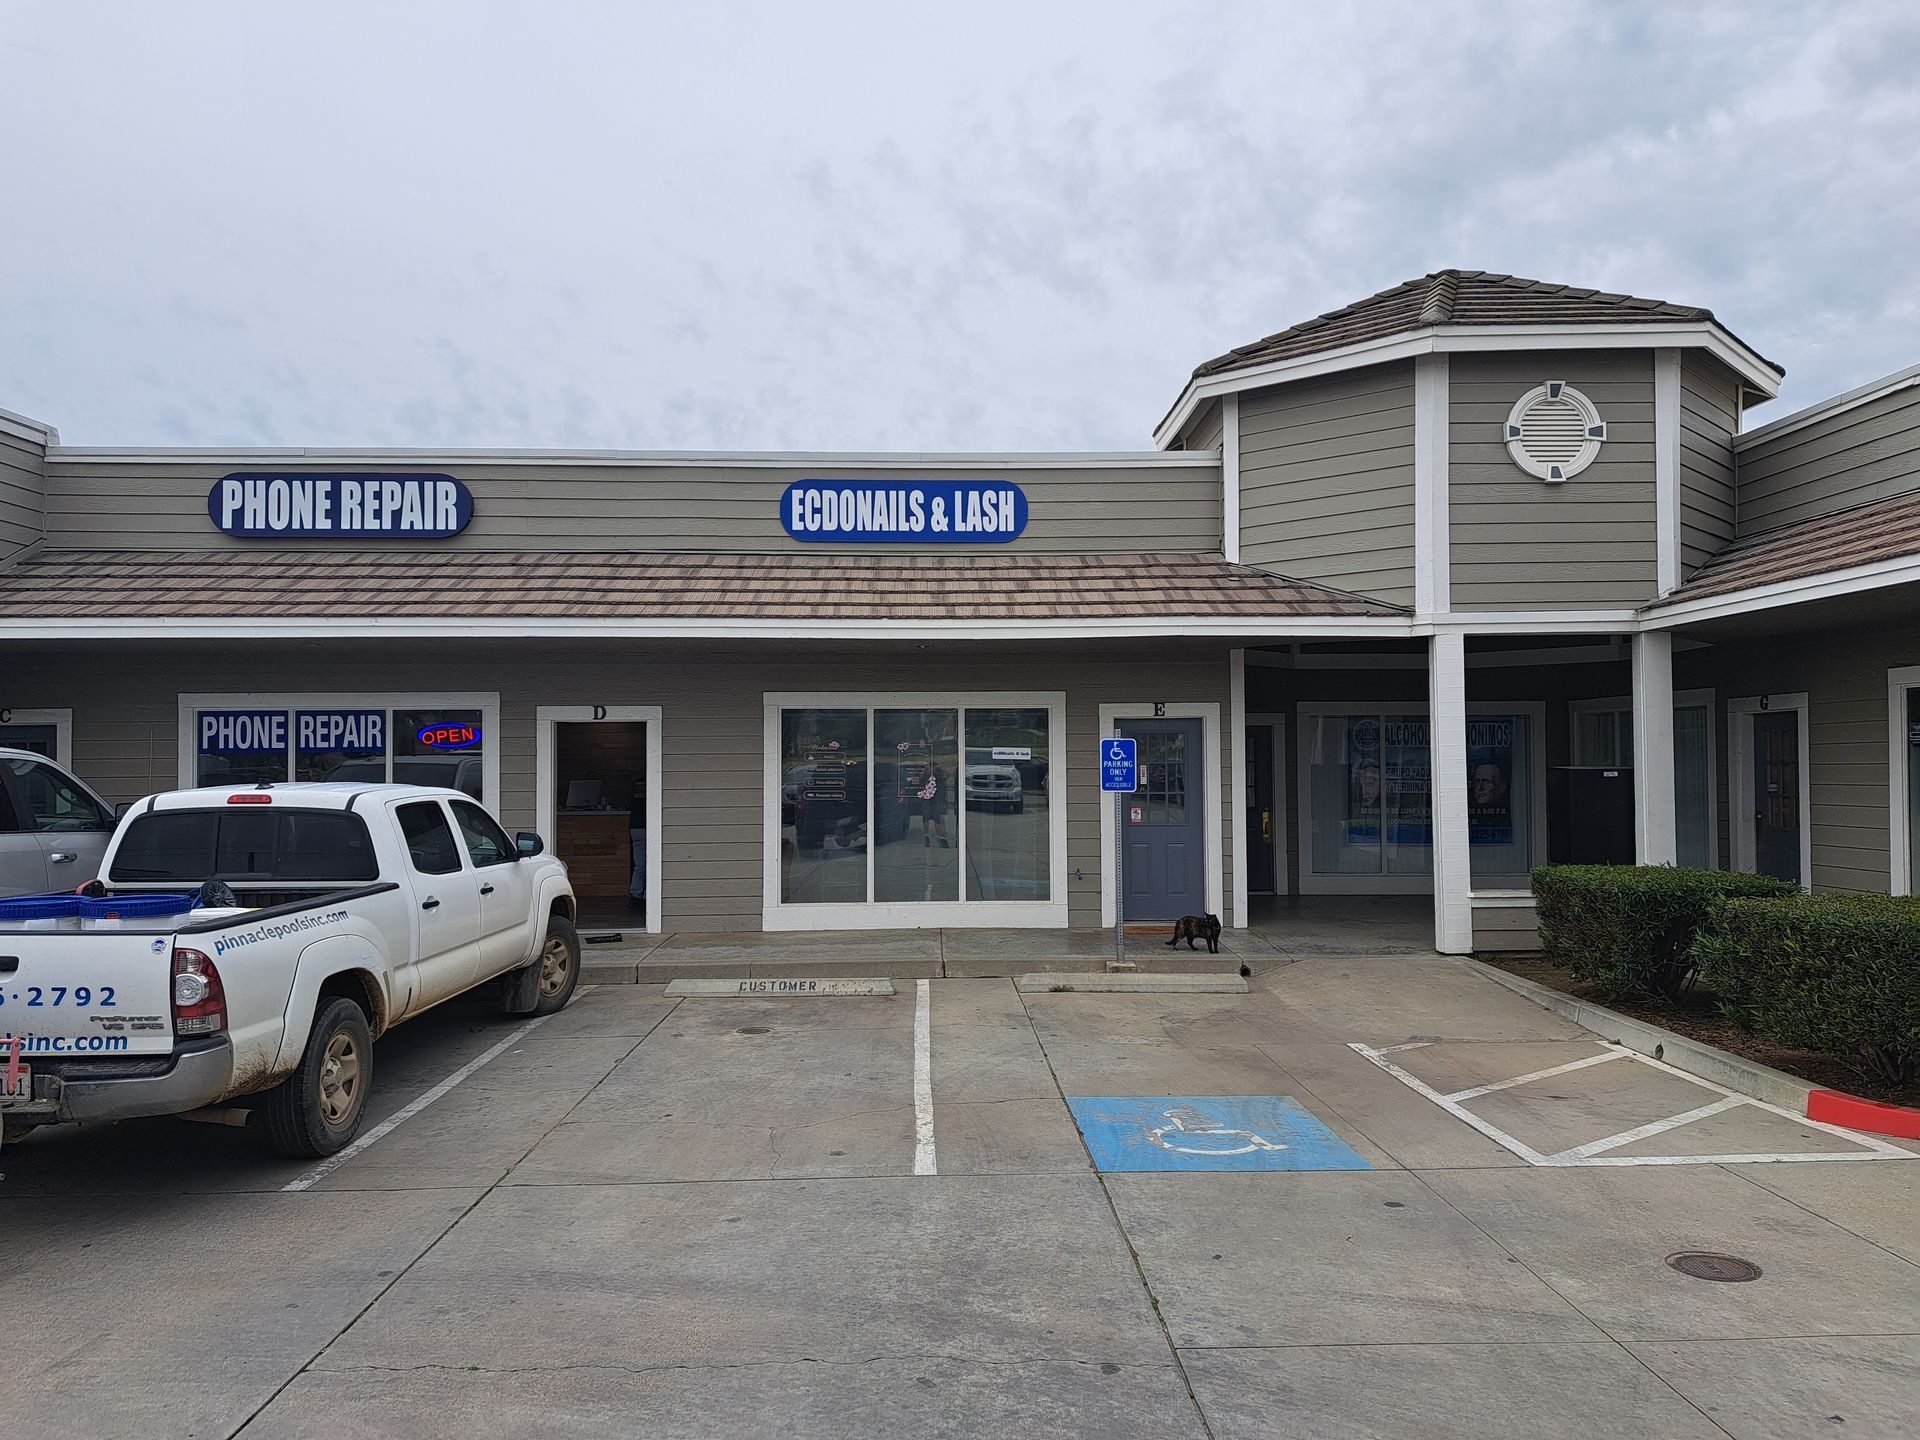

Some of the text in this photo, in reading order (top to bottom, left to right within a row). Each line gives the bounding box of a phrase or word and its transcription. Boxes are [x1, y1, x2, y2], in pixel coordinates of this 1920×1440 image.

[222, 479, 457, 530] PHONE REPAIR
[791, 488, 1015, 532] ECDONAILS & LASH
[1153, 702, 1166, 716] E
[1759, 695, 1769, 711] G
[592, 705, 607, 720] D
[202, 715, 382, 749] PHONE REPAIR
[421, 727, 475, 745] OPEN
[1384, 722, 1431, 747] ALCOHOL
[1103, 760, 1134, 768] PARKING
[1109, 768, 1128, 776] ONLY
[1391, 781, 1426, 793] TERMINA
[214, 909, 350, 955] pinnaclepoolsinc.com
[739, 981, 817, 992] CUSTOMER
